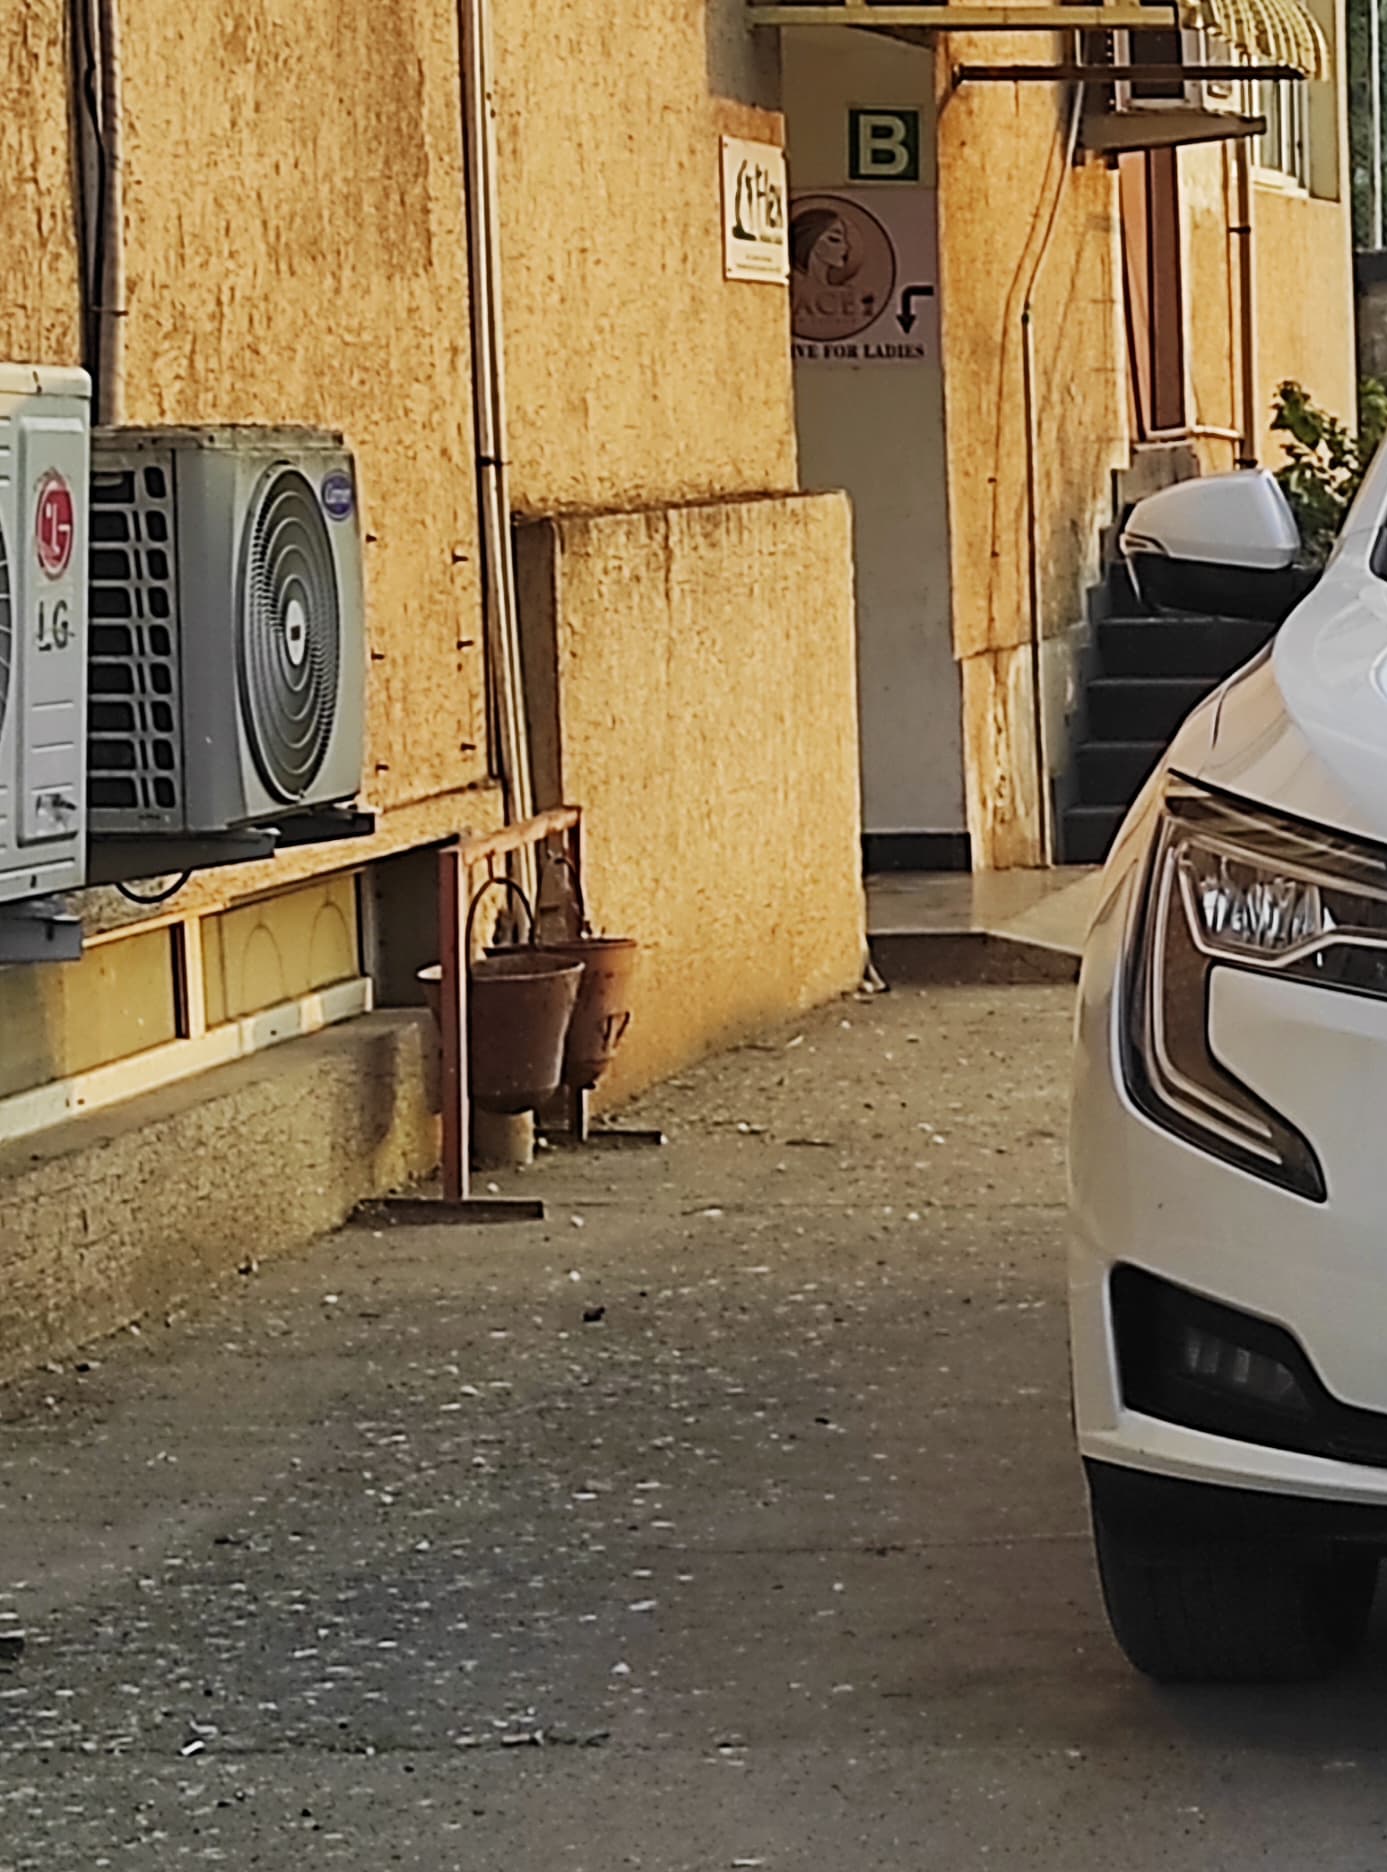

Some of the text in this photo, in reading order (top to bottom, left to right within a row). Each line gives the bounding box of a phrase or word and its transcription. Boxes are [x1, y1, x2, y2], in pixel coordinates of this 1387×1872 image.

[858, 114, 909, 175] B
[823, 344, 858, 359] FOR
[864, 343, 925, 359] LADIES
[37, 600, 69, 650] LG
